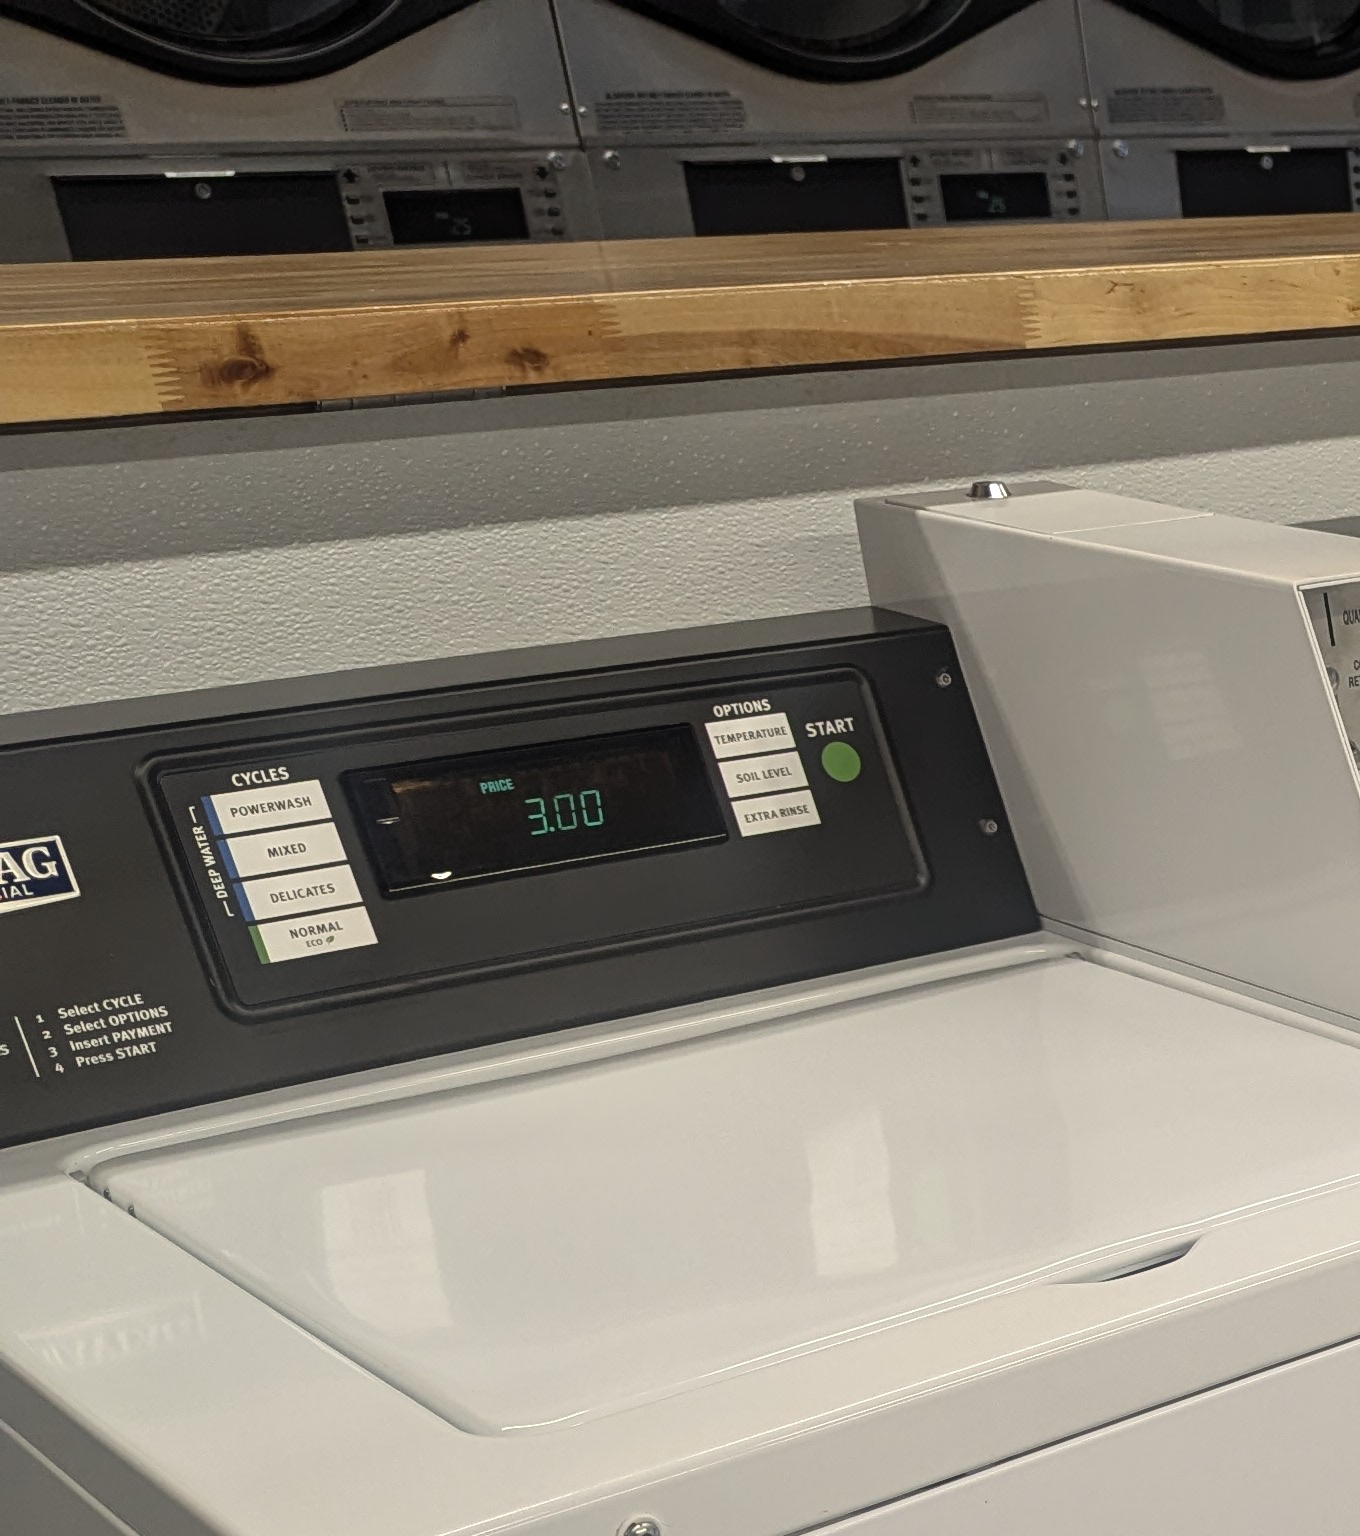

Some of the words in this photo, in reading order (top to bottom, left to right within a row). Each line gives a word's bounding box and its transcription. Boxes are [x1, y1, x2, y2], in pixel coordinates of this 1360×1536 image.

[713, 698, 772, 718] OPTIONS
[714, 726, 788, 745] TEMPERATURE
[805, 717, 855, 738] START
[231, 766, 290, 787] CYCLES
[736, 771, 761, 784] SOIL
[762, 766, 792, 780] LEVEL
[480, 778, 515, 795] PRICE
[229, 796, 313, 818] POWERWASH
[525, 789, 604, 836] 3.00
[744, 809, 778, 824] EXTRA
[779, 804, 811, 818] RINSE
[192, 825, 215, 867] WATER
[267, 842, 307, 859] MIXED
[0, 883, 34, 900] IAL
[208, 870, 229, 899] DEEP
[269, 883, 336, 904] DELICATES
[289, 921, 344, 940] NORMAL
[305, 938, 323, 948] ECO
[36, 1014, 45, 1024] 1
[57, 1002, 102, 1019] Select
[102, 993, 145, 1011] CYCLE
[41, 1030, 52, 1040] 2
[63, 1017, 107, 1036] Select
[108, 1005, 169, 1027] OPTIONS
[48, 1046, 59, 1058] 3
[69, 1034, 111, 1052] Insert
[112, 1021, 173, 1043] PAYMENT
[55, 1062, 65, 1074] 4
[75, 1051, 115, 1068] Press
[115, 1041, 157, 1060] START
